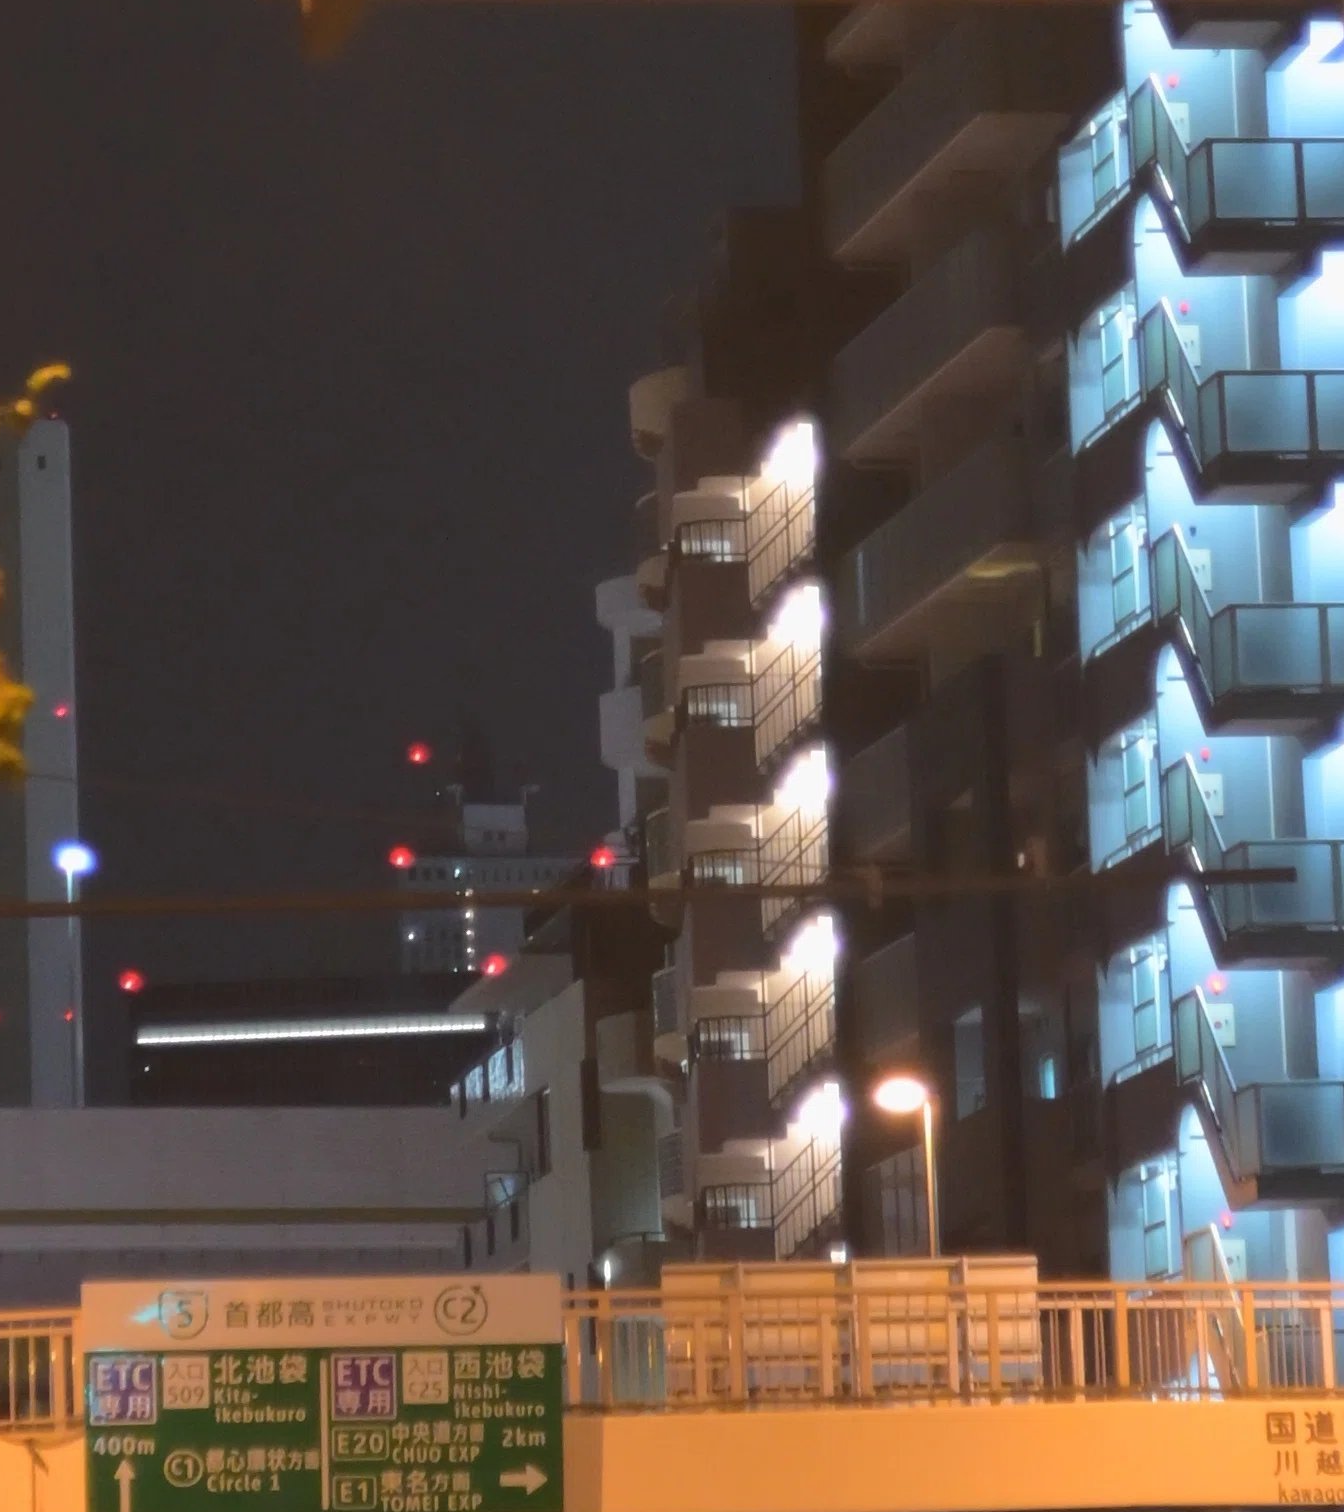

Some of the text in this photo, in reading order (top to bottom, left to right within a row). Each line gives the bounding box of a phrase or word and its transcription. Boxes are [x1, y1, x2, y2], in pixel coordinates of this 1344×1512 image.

[225, 1299, 315, 1328] 首都高
[322, 1298, 423, 1311] SHUTOKO
[442, 1296, 478, 1326] C2
[169, 1362, 205, 1381] 入口
[214, 1354, 307, 1385] 北池袋
[336, 1358, 391, 1388] ETC
[407, 1358, 444, 1376] 入口
[453, 1349, 546, 1380] 西池袋
[96, 1363, 150, 1391] ETC
[98, 1395, 151, 1420] 専用
[336, 1388, 391, 1415] 専用
[454, 1401, 546, 1419] ikebukuro
[214, 1405, 307, 1424] ikebukuro
[93, 1435, 155, 1456] 400m
[336, 1432, 384, 1455] E20
[501, 1427, 547, 1448] 2km
[392, 1445, 481, 1464] CHUO EXP
[170, 1458, 195, 1480] C1
[206, 1474, 281, 1493] Circle 1
[339, 1479, 369, 1504] E1
[381, 1470, 472, 1495] 東名方面
[381, 1493, 483, 1512] TOMEI EXP
